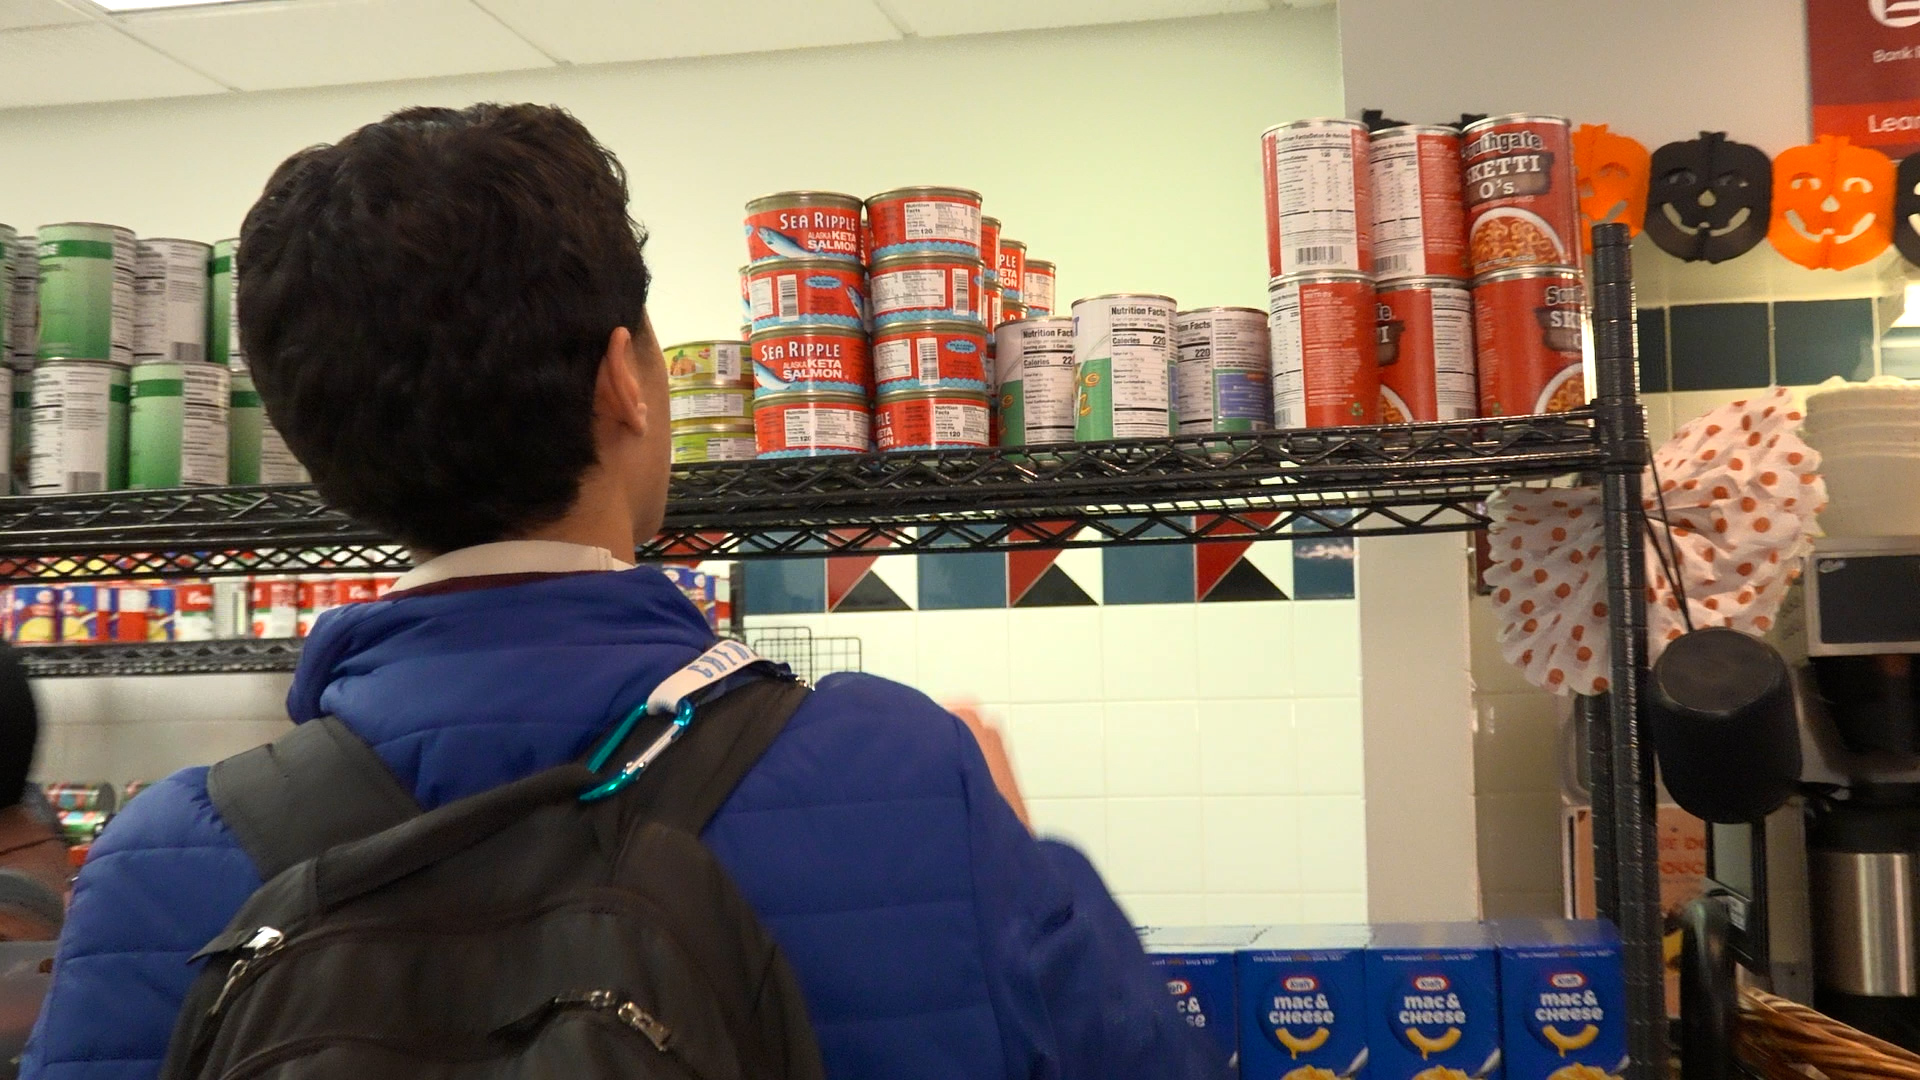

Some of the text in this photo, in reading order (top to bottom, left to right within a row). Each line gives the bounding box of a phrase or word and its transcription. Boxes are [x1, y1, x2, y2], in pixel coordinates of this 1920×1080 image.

[1479, 179, 1515, 199] O's
[780, 211, 855, 232] SEA RIPPLE
[807, 230, 856, 243] ALASKA KETA
[807, 240, 857, 253] SALMON
[999, 254, 1017, 269] PLE
[1000, 268, 1018, 279] ETA
[1111, 306, 1166, 317] Nutrition Facts
[1190, 321, 1211, 331] Facts
[1023, 328, 1073, 338] Nutrition Fact
[1152, 335, 1166, 346] 220
[761, 341, 840, 361] SEA RIPPLE
[783, 358, 842, 369] ALASKA KETA
[1062, 355, 1073, 365] 22
[783, 368, 842, 380] SALMON
[877, 427, 893, 439] ETA
[1274, 992, 1330, 1010] mac &
[1404, 992, 1461, 1010] mac &
[1540, 989, 1599, 1007] mac &
